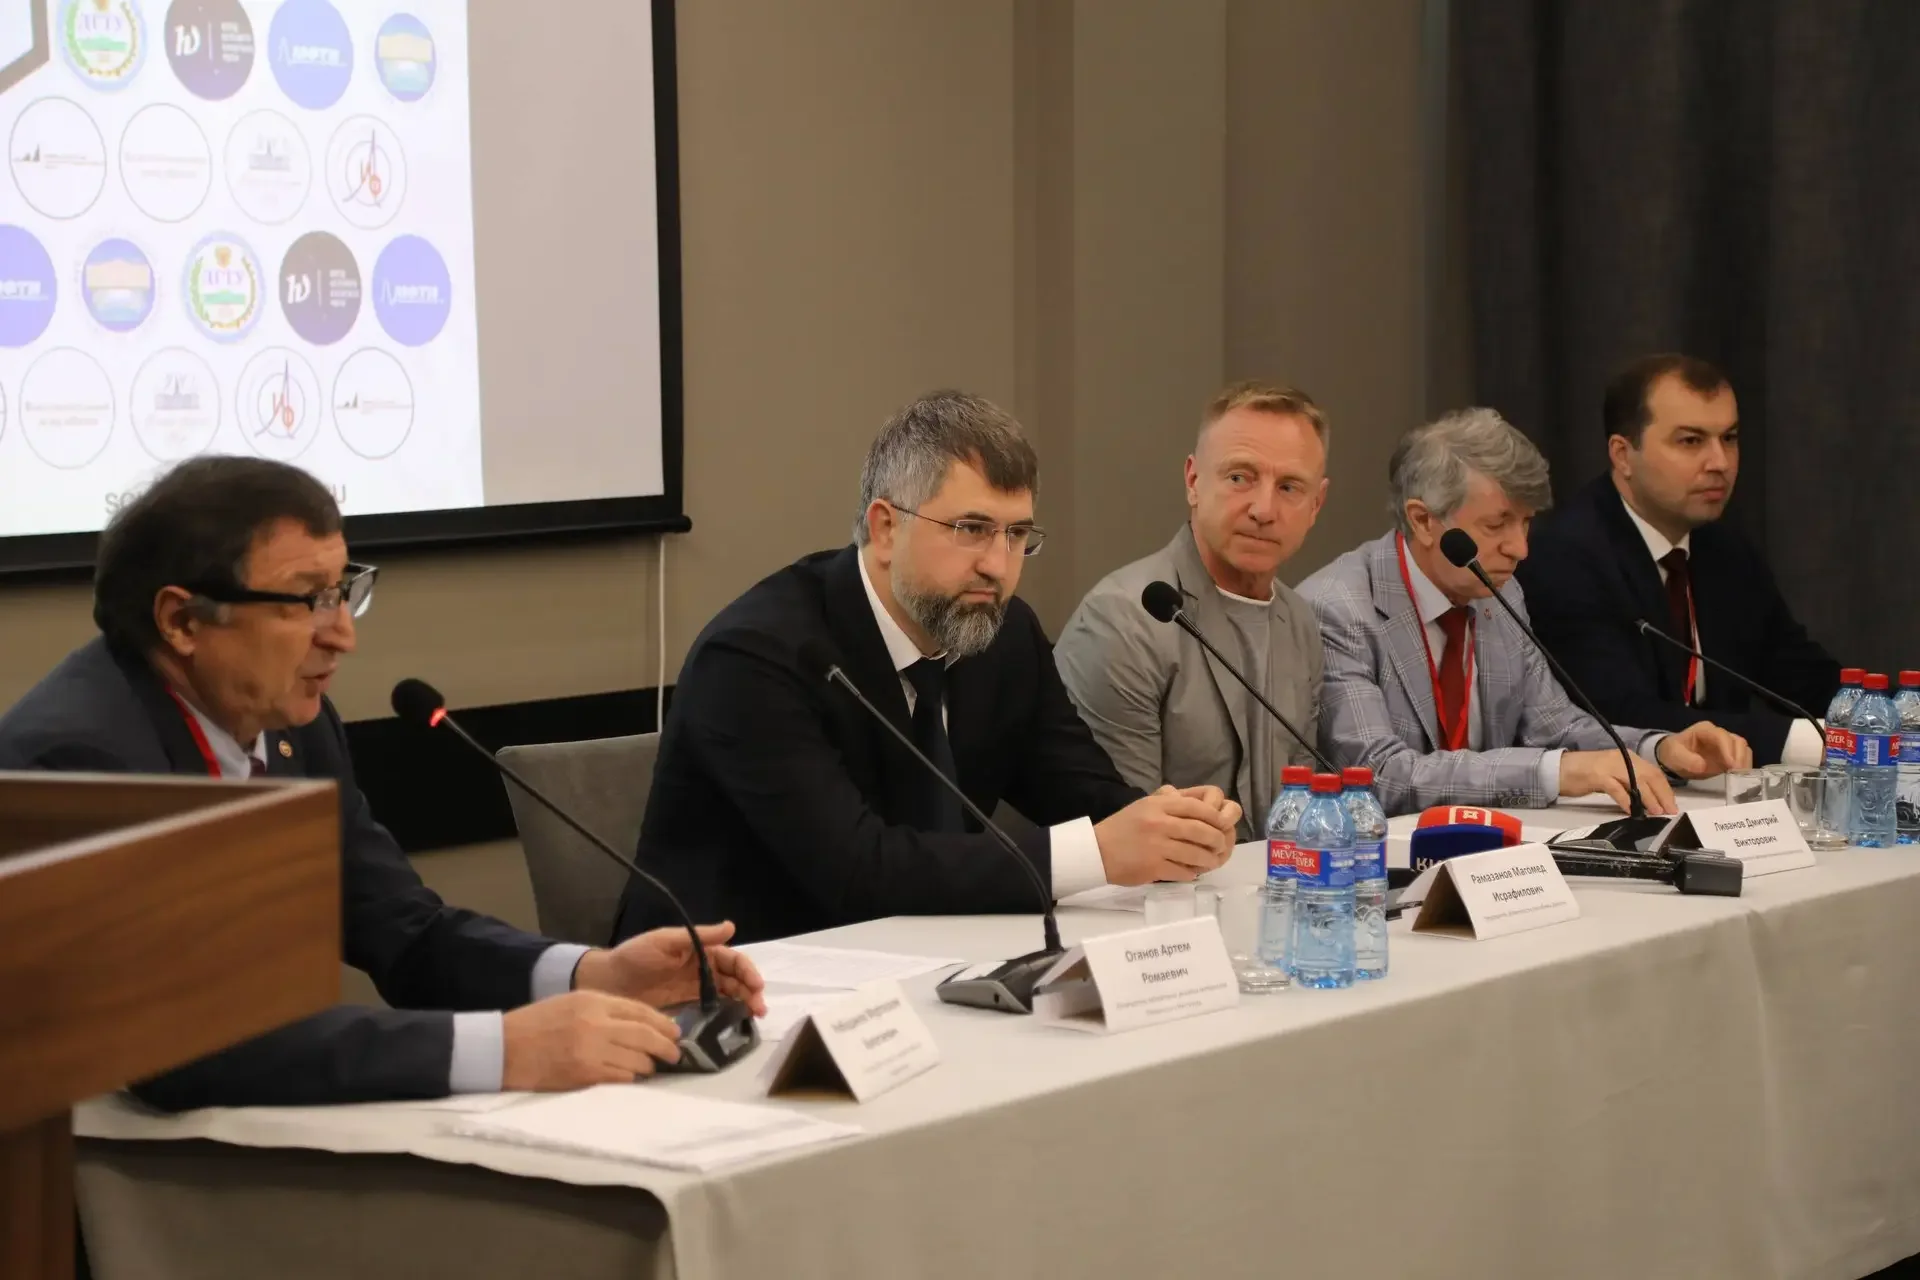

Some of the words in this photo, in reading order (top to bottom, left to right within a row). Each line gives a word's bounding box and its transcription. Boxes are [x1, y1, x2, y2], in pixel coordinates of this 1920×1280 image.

[1826, 734, 1846, 744] EVER
[1714, 820, 1746, 832] Ливанов
[1746, 814, 1779, 828] Дмитрий
[1733, 835, 1778, 848] Викторович
[1272, 849, 1297, 860] MEVE
[1471, 869, 1512, 885] Рамазанов
[1512, 864, 1547, 877] Магомед
[1492, 884, 1544, 903] Исрафилович
[1125, 948, 1159, 963] Оганов
[1161, 941, 1192, 958] Артем
[1141, 967, 1189, 984] Ромаевич
